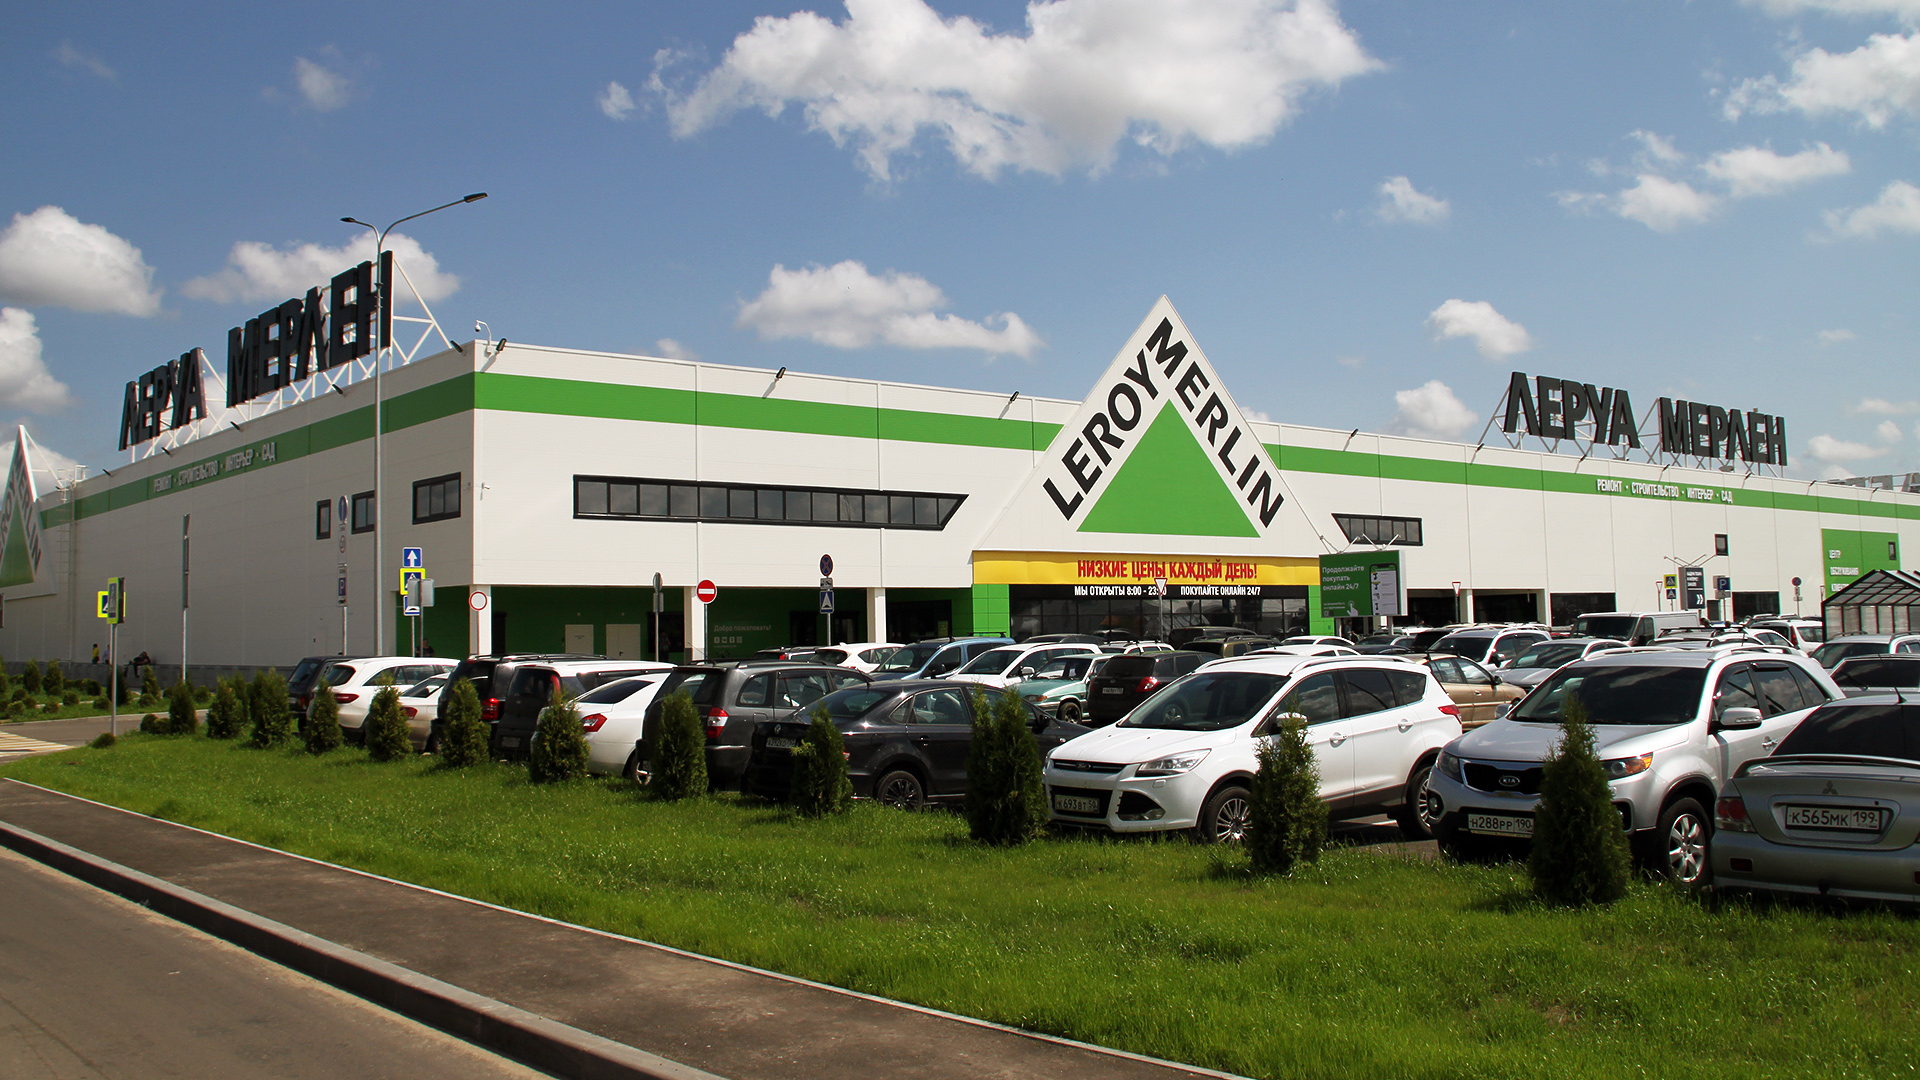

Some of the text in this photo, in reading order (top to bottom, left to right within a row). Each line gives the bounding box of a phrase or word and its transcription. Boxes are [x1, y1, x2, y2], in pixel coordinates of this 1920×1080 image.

[119, 250, 392, 450] ЛЕРУА МЕРЛЕН
[1042, 316, 1285, 528] LEROY MERLIN
[1503, 371, 1788, 466] ЛЕРУА МЕРЛЕН
[1596, 479, 1733, 504] РЕМОНТ СТРОИТЕЛЬСТВО ИНТЕРЬЕР САД
[1078, 559, 1257, 582] НИЗКИЕ ЦЕНЫ КАЖДЫЙ ДЕНЬ!
[1322, 565, 1365, 574] Продолжайте
[1322, 575, 1350, 583] покупать
[1074, 585, 1088, 596] МЫ
[1089, 585, 1125, 596] ОТКРЫТЫ
[1126, 586, 1142, 596] 8:00
[1148, 586, 1167, 596] 23:0
[1180, 584, 1261, 596] ПОКУПАЙТЕ ОНЛАЙН 24/7
[1515, 818, 1531, 829] 190
[1853, 811, 1876, 824] 199
